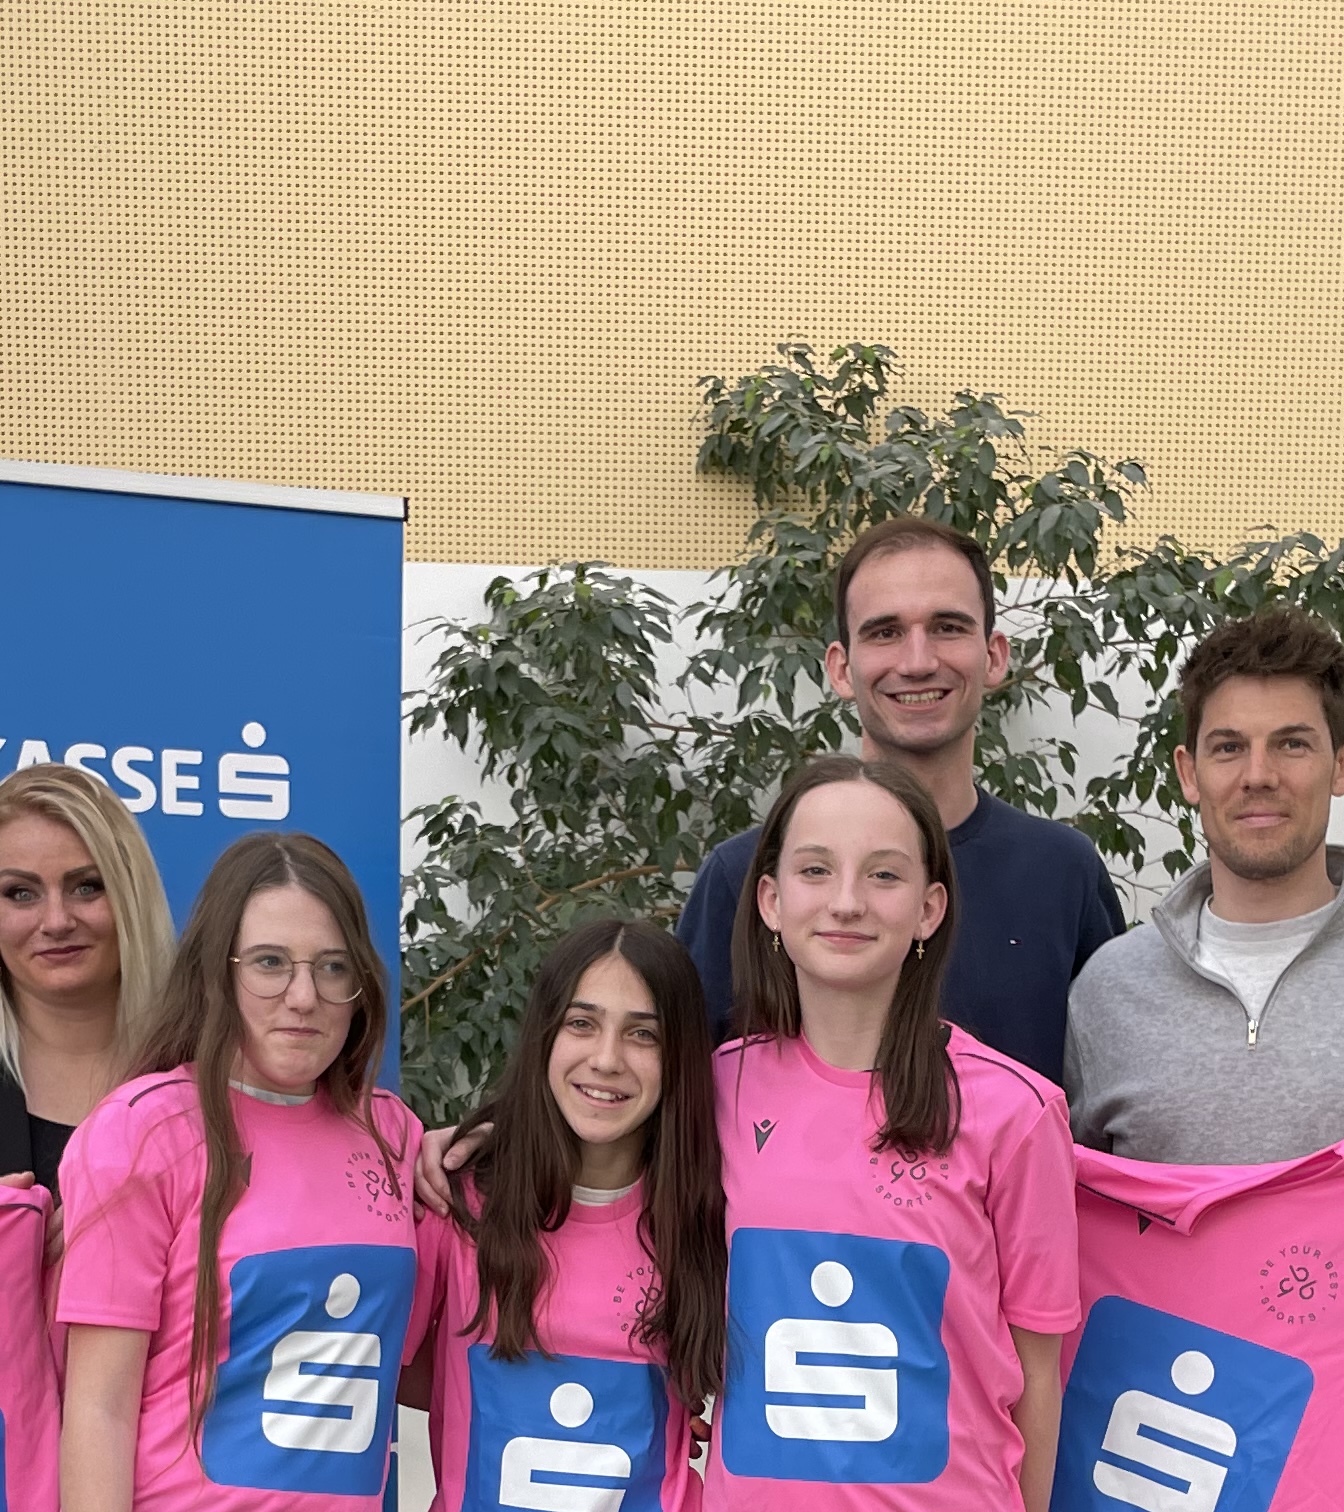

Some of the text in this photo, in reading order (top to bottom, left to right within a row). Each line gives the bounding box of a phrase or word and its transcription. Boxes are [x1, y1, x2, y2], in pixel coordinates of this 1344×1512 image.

[875, 1185, 932, 1207] SPORTS
[626, 1264, 656, 1281] YOU
[1279, 1245, 1321, 1259] YOUR
[1324, 1261, 1339, 1301] BEST
[1260, 1296, 1317, 1325] SPORTS
